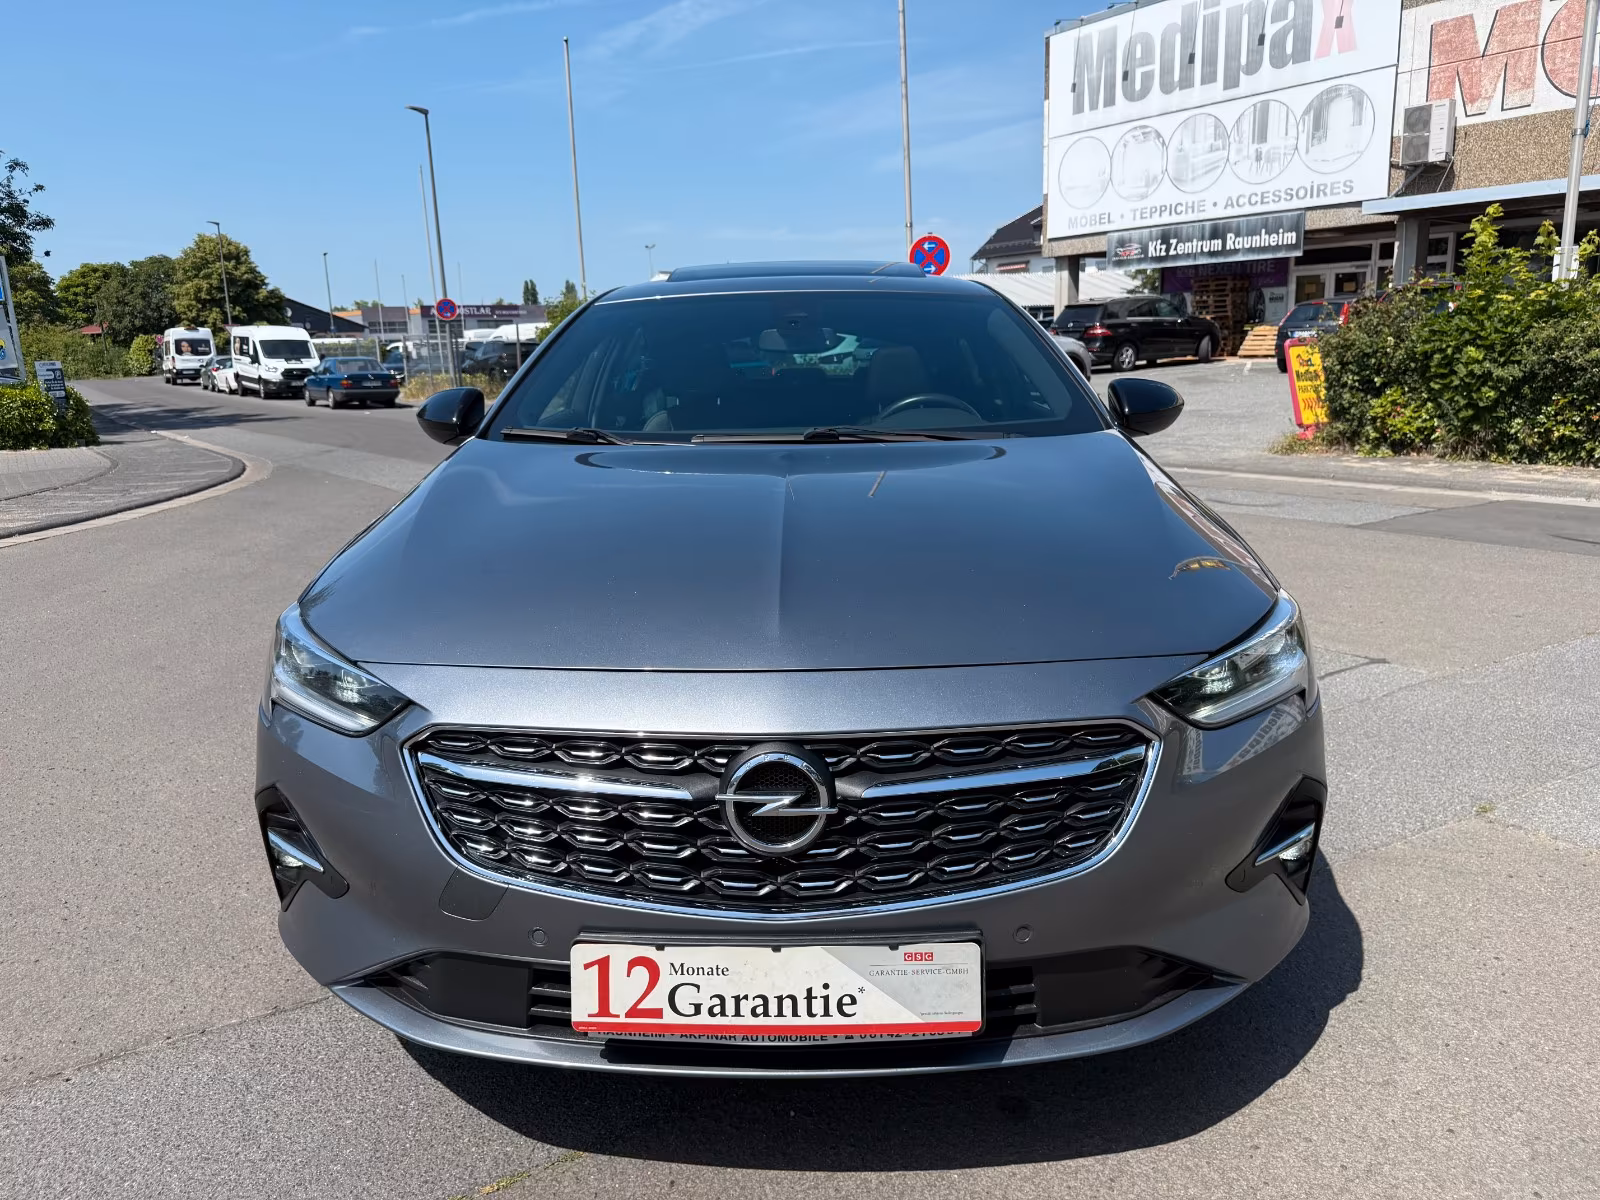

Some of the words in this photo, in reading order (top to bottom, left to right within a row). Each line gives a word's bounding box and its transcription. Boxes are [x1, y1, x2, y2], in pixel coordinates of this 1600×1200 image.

[1072, 0, 1359, 115] Medipax
[1130, 200, 1206, 221] TEPPICHE
[1148, 239, 1167, 257] Kfz
[1169, 237, 1222, 255] Zentrum
[1226, 229, 1297, 250] Raunheim
[1246, 261, 1276, 274] TIRE
[904, 952, 933, 961] GSG
[668, 962, 730, 977] Monate
[583, 954, 663, 1019] 12
[741, 1034, 829, 1042] AUTOMOBILE
